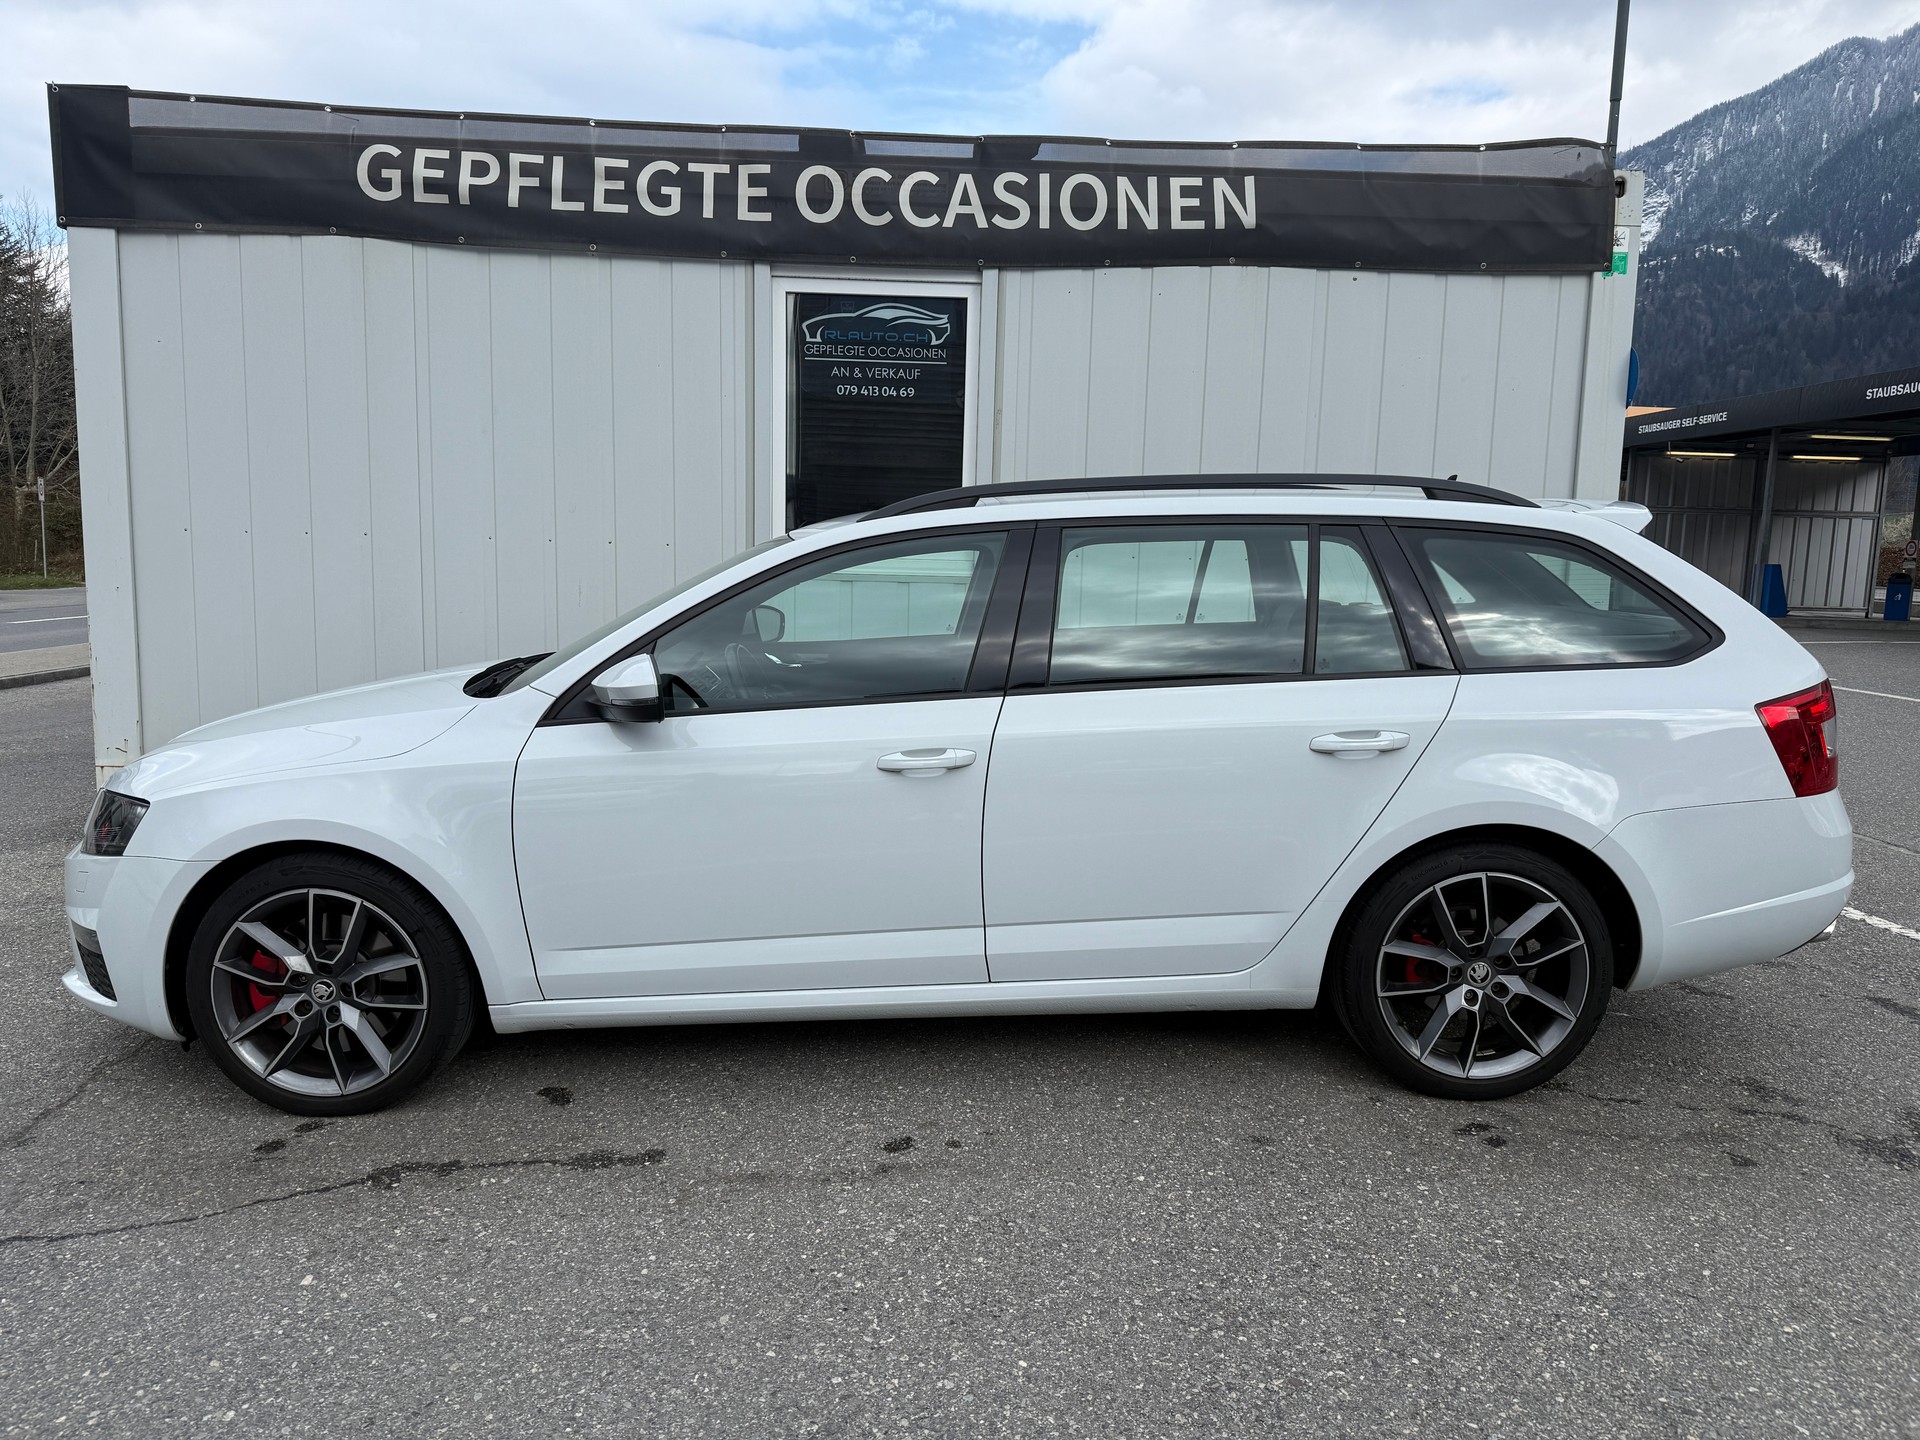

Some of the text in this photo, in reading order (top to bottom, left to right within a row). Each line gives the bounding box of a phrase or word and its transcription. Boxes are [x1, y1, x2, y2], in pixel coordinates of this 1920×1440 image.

[356, 143, 1257, 231] GEPFLEGTE OCCASIONEN
[824, 330, 928, 343] RLAUTO.CH
[804, 344, 947, 359] GEPFLEGTE OCCASIONEN
[831, 366, 921, 380] AN & VERKAUF
[836, 385, 915, 397] 079 413 04 69
[1638, 412, 1728, 434] STAUBSAUGER SELF-SERVICE
